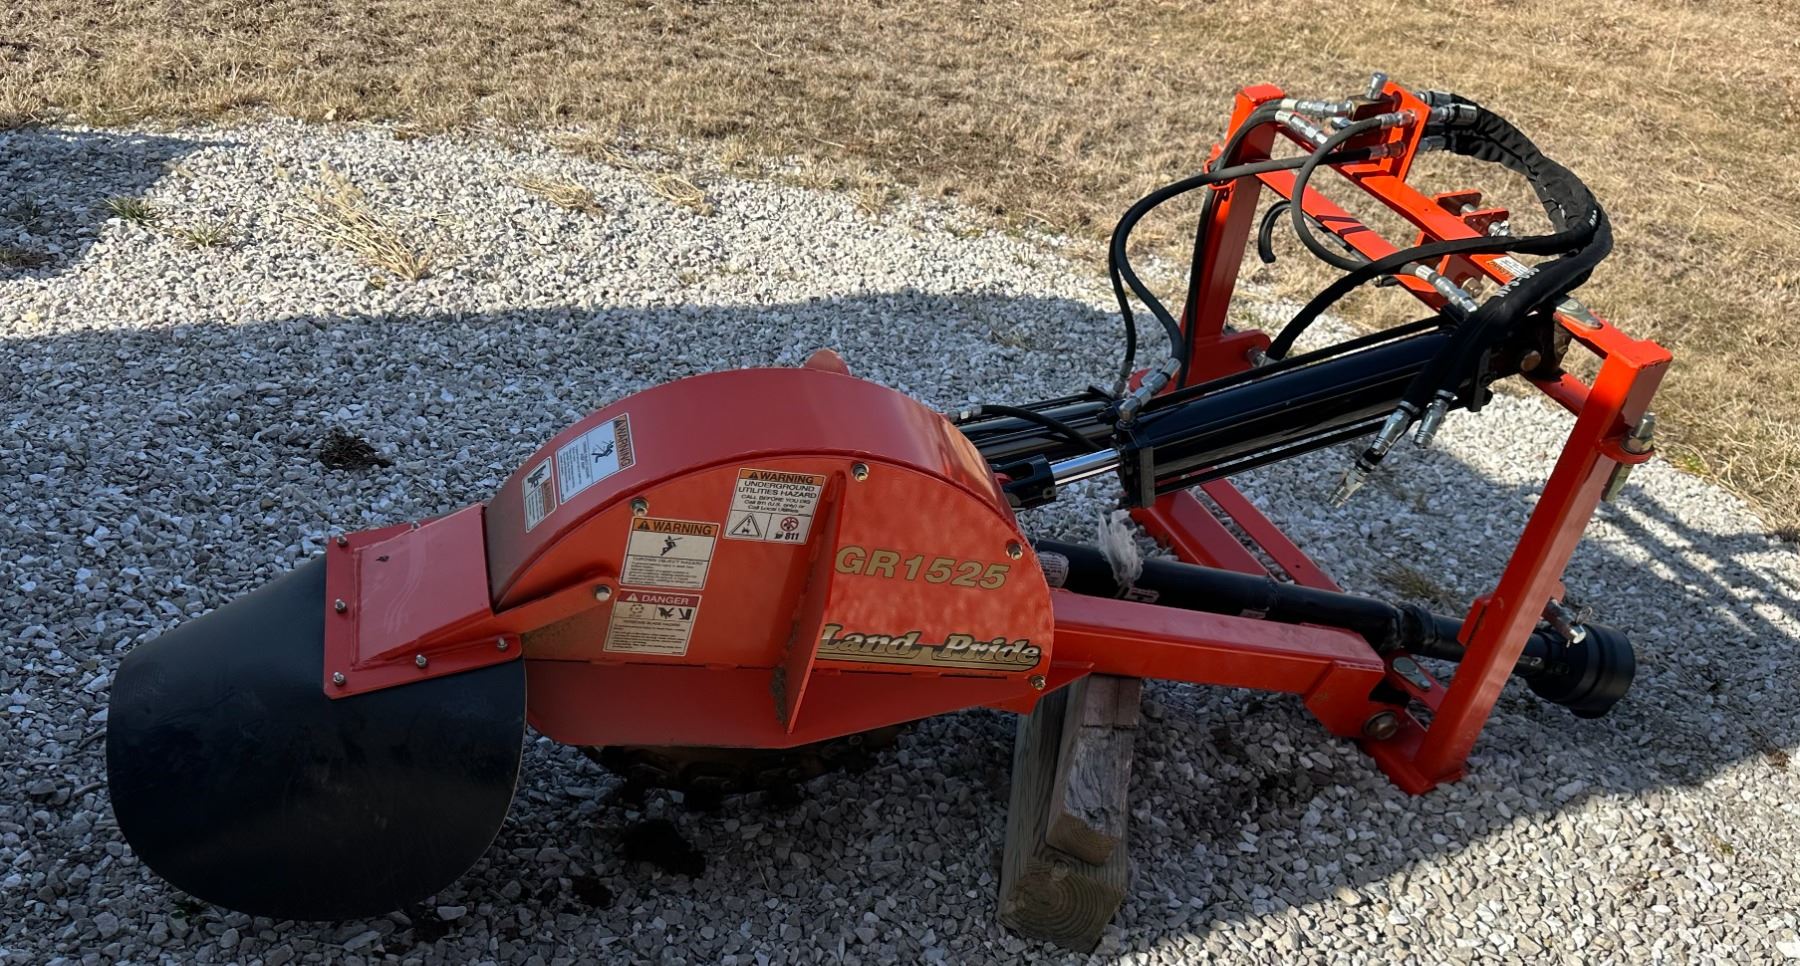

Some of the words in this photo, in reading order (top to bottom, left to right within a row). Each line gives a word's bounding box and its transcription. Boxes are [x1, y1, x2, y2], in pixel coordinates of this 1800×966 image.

[760, 472, 814, 484] WARNING
[744, 480, 815, 492] UNDERGROUND
[738, 487, 778, 496] UTILITIES
[780, 491, 817, 499] HAZARD
[653, 520, 712, 536] WARNING
[784, 532, 800, 541] 811
[834, 546, 1011, 590] GR1525
[641, 594, 689, 606] DANGER
[821, 623, 921, 657] Land
[937, 633, 1040, 664] Pride
